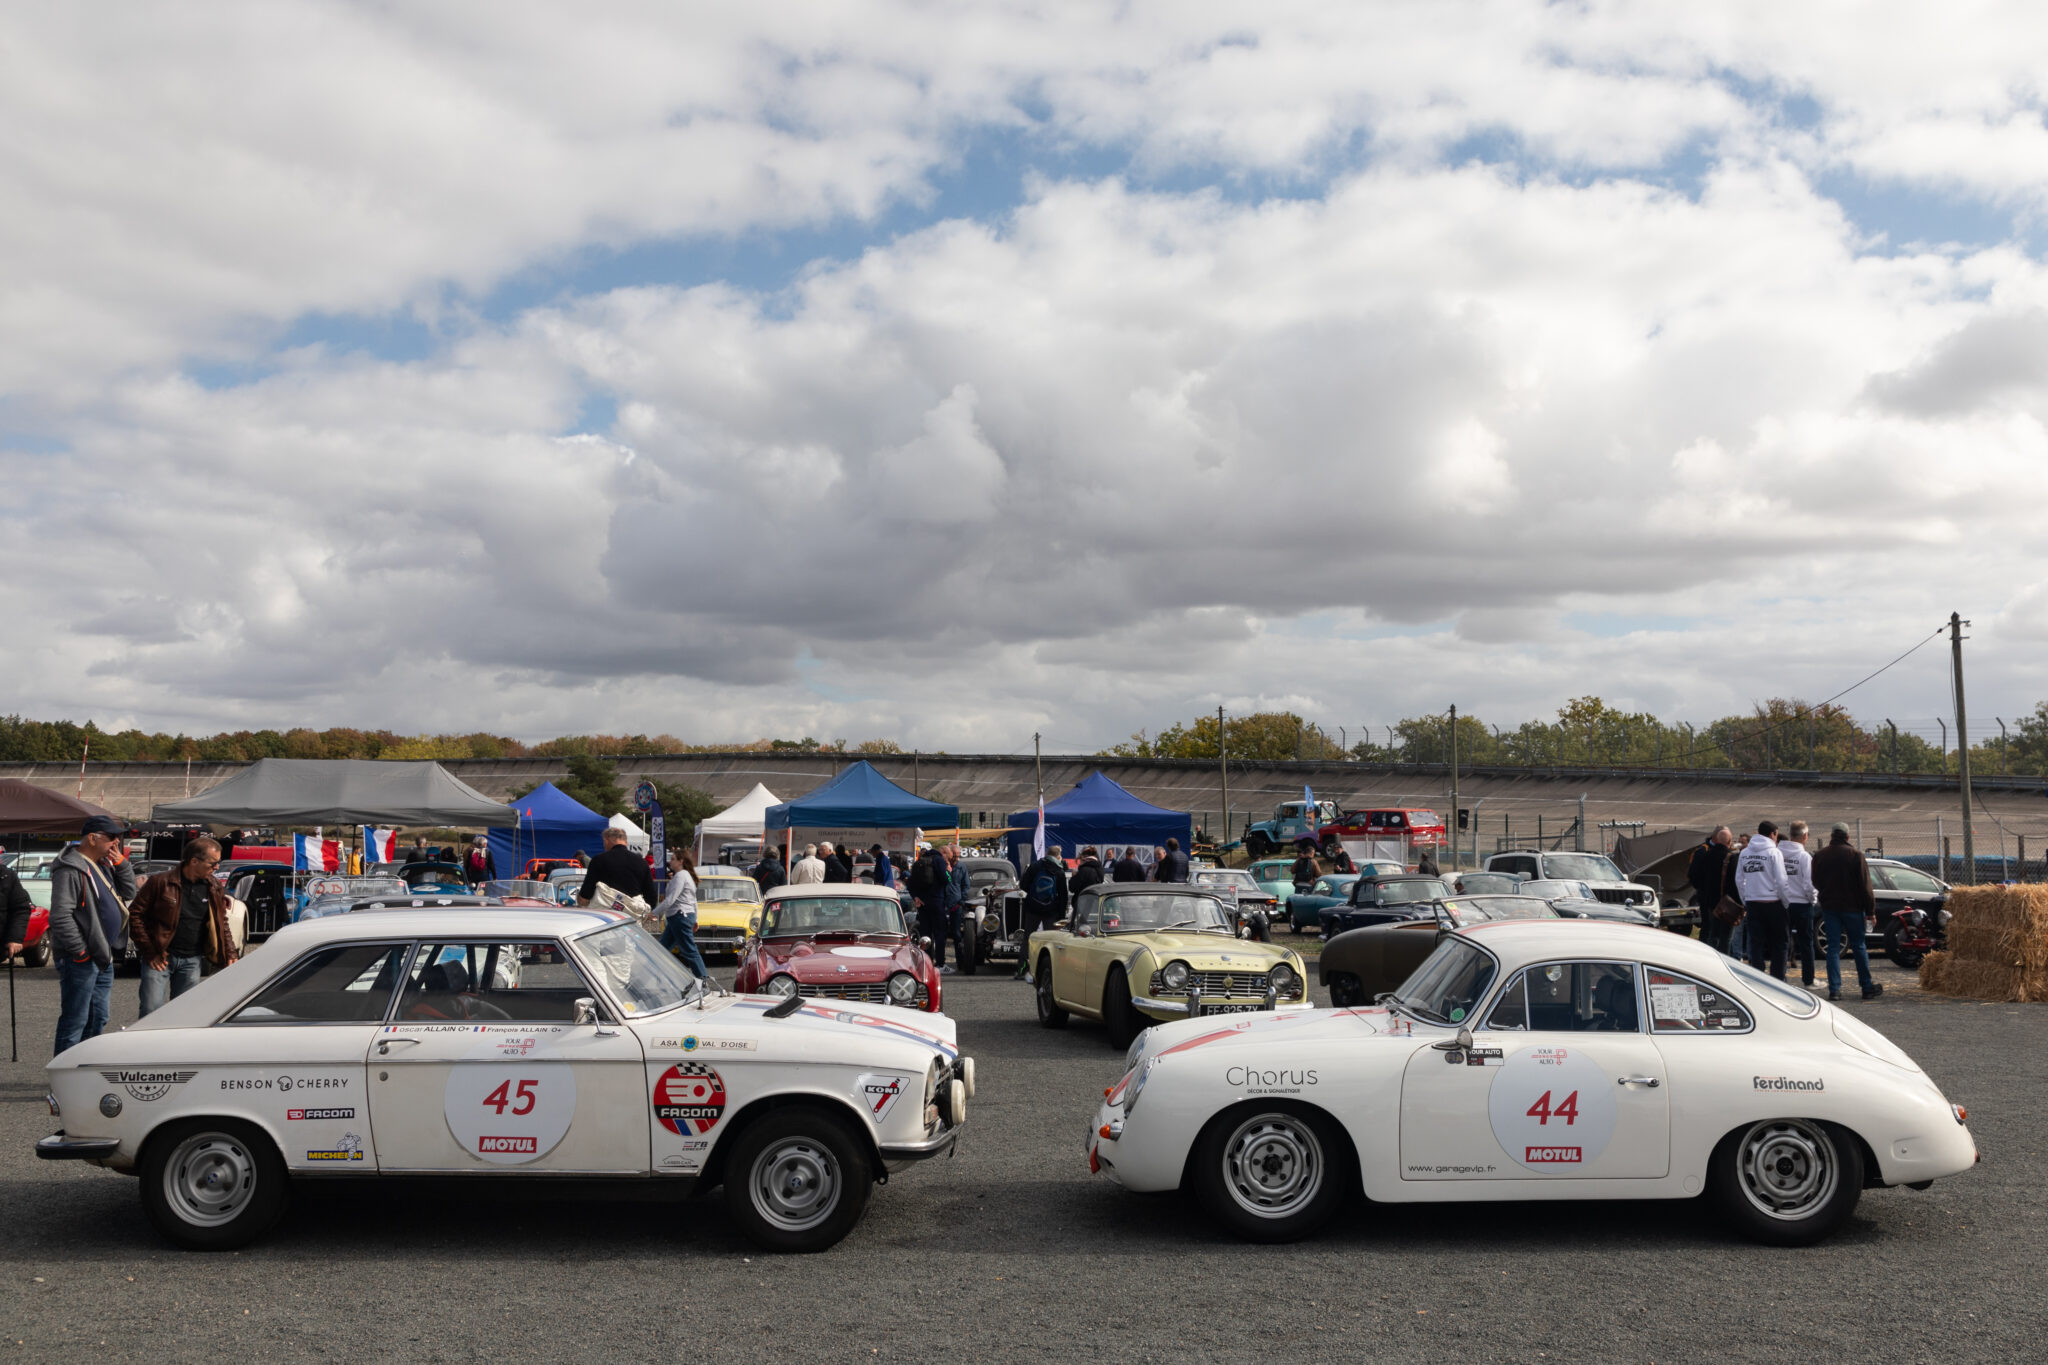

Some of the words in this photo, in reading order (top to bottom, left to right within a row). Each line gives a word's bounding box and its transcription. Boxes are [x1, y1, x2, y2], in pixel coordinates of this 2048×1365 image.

[119, 1071, 179, 1082] Vulcanet
[1226, 1065, 1318, 1086] Chorus
[220, 1080, 273, 1090] BENSON
[296, 1078, 349, 1089] CHERRY
[867, 1086, 899, 1094] KONI
[482, 1079, 539, 1115] 45
[661, 1108, 718, 1117] FACOM
[1526, 1090, 1579, 1125] 44
[305, 1109, 354, 1119] FACOM
[481, 1138, 535, 1151] MOTUL
[308, 1151, 363, 1160] MICHELN
[1528, 1148, 1580, 1161] MOTUL
